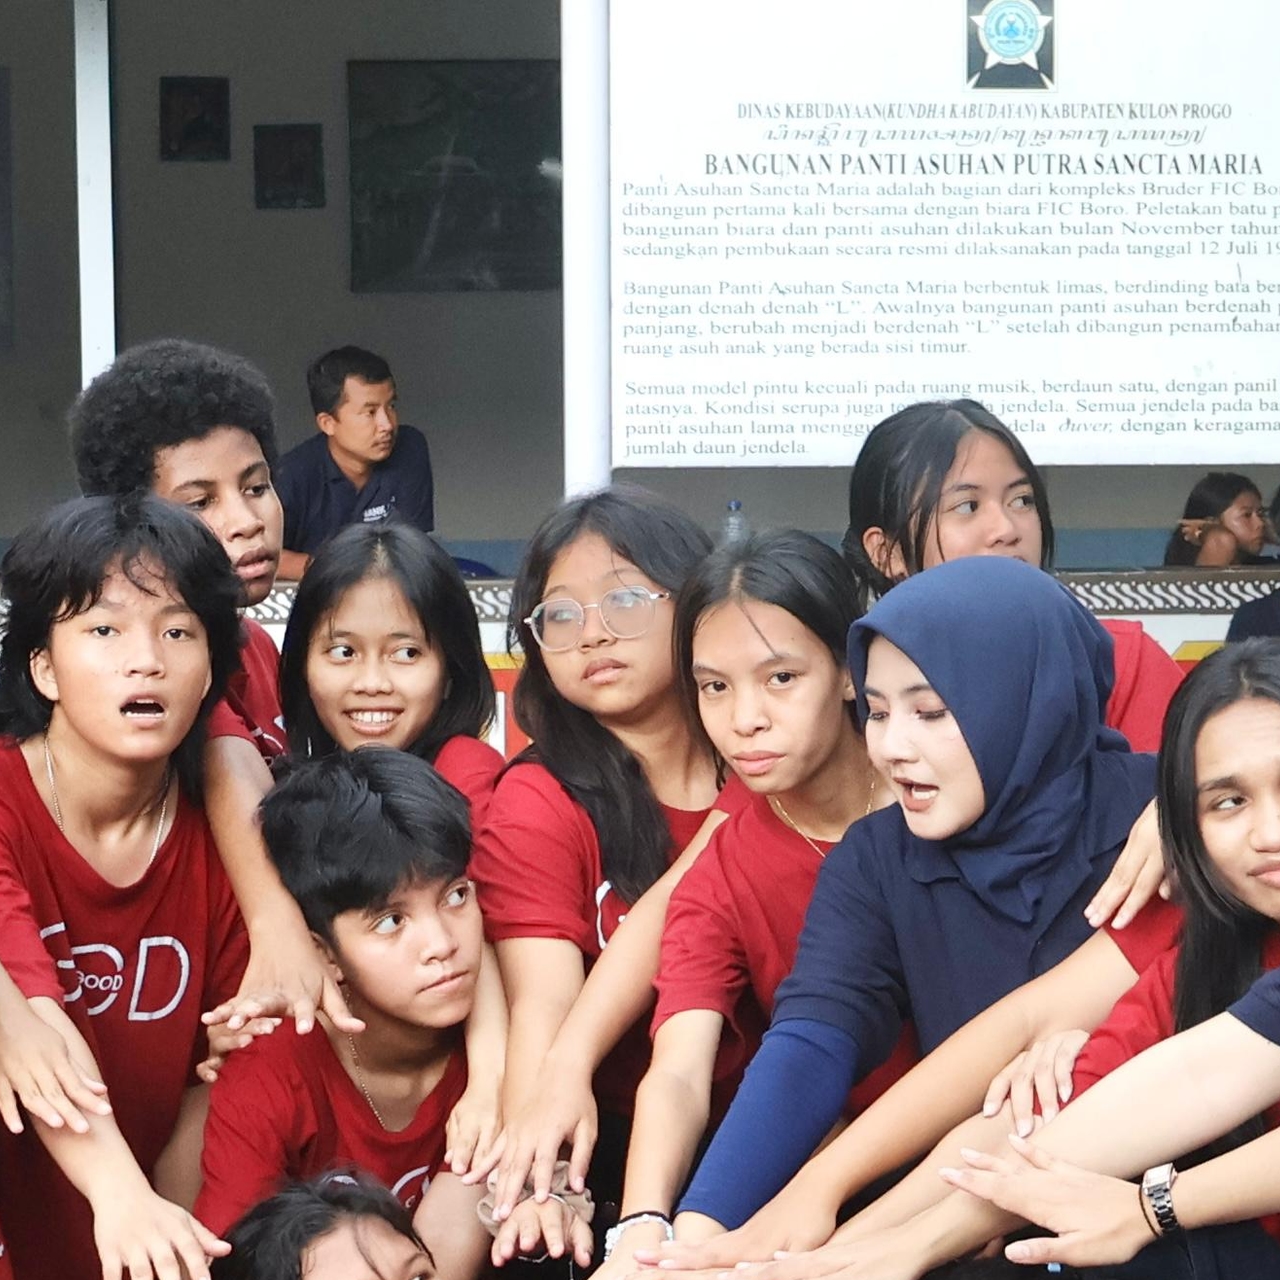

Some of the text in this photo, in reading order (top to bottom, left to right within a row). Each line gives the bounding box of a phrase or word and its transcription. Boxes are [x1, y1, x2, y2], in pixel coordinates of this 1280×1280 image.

[737, 102, 782, 119] DINAS
[1040, 102, 1125, 120] KABUPATEN
[1127, 101, 1179, 121] KULON
[1181, 102, 1233, 120] PROGO
[704, 152, 1264, 178] BANGUNAN PANTI ASUHAN PUTRA SANCTA MARIA
[622, 182, 668, 196] Panti
[673, 181, 743, 197] Asuhan
[749, 182, 810, 197] Sancta
[816, 182, 871, 196] Maria
[875, 181, 936, 196] adalah
[941, 181, 1002, 200] bagian
[1006, 182, 1042, 196] dari
[1048, 181, 1136, 200] kompleks
[1141, 181, 1205, 196] Bruder
[1210, 181, 1247, 196] FIC
[621, 202, 707, 219] dibangun
[712, 203, 787, 219] pertama
[792, 201, 826, 216] kali
[832, 201, 909, 216] bersama
[913, 201, 980, 219] dengan
[985, 201, 1031, 216] biara
[1037, 201, 1074, 216] FIC
[1079, 201, 1129, 216] Boro.
[1135, 201, 1223, 216] Peletakan
[1228, 201, 1268, 216] batu
[622, 221, 719, 240] bangunan
[726, 221, 776, 236] biara
[781, 221, 818, 236] dan
[824, 223, 874, 240] panti
[880, 221, 950, 236] asuhan
[955, 221, 1053, 236] dilakukan
[1059, 221, 1114, 236] bulan
[1120, 220, 1225, 236] November
[622, 241, 719, 260] sedangkan
[724, 241, 830, 260] pembukaan
[835, 244, 893, 256] secara
[898, 244, 949, 256] resmi
[954, 241, 1072, 256] dilaksanakan
[1076, 241, 1121, 259] pada
[1125, 240, 1192, 259] tanggal
[1200, 240, 1220, 255] 12
[1225, 240, 1259, 256] Juli
[623, 281, 712, 298] Bangunan
[718, 280, 763, 295] Panti
[768, 280, 836, 297] Asuhan
[841, 280, 900, 295] Sancta
[905, 280, 958, 295] Maria
[963, 279, 1051, 295] berbentuk
[1056, 279, 1109, 295] limas,
[1114, 279, 1210, 298] berdinding
[1213, 280, 1251, 295] bata
[622, 300, 692, 318] dengan
[698, 300, 756, 315] denah
[761, 300, 819, 315] denah
[872, 299, 956, 318] Awalnya
[962, 299, 1054, 318] bangunan
[1059, 298, 1107, 318] panti
[1112, 299, 1179, 314] asuhan
[1185, 299, 1272, 314] berdenah
[622, 320, 703, 338] panjang,
[709, 320, 786, 335] berubah
[791, 319, 867, 338] menjadi
[873, 319, 960, 334] berdenah
[1006, 319, 1070, 334] setelah
[1076, 318, 1164, 337] dibangun
[622, 339, 971, 358] ruang asuh anak yang berada sisi timur.
[625, 381, 686, 396] Semua
[691, 380, 747, 396] model
[752, 380, 799, 398] pintu
[804, 380, 868, 395] kecuali
[874, 380, 916, 398] pada
[921, 382, 972, 398] ruang
[977, 379, 1037, 394] musik,
[1041, 378, 1114, 394] berdaun
[1118, 380, 1160, 395] satu,
[1164, 378, 1229, 397] dengan
[1233, 377, 1278, 397] panil
[625, 403, 697, 418] atasnya.
[704, 400, 775, 415] Kondisi
[781, 402, 840, 418] serupa
[845, 401, 885, 418] juga
[1076, 398, 1137, 413] Semua
[1140, 398, 1206, 416] jendela
[1211, 397, 1254, 416] pada
[625, 420, 672, 438] panti
[678, 420, 744, 435] asuhan
[750, 419, 795, 435] lama
[801, 421, 874, 438] menggu
[1010, 418, 1047, 434] dela
[1120, 417, 1188, 436] dengan
[623, 440, 688, 457] jumlah
[692, 440, 736, 455] daun
